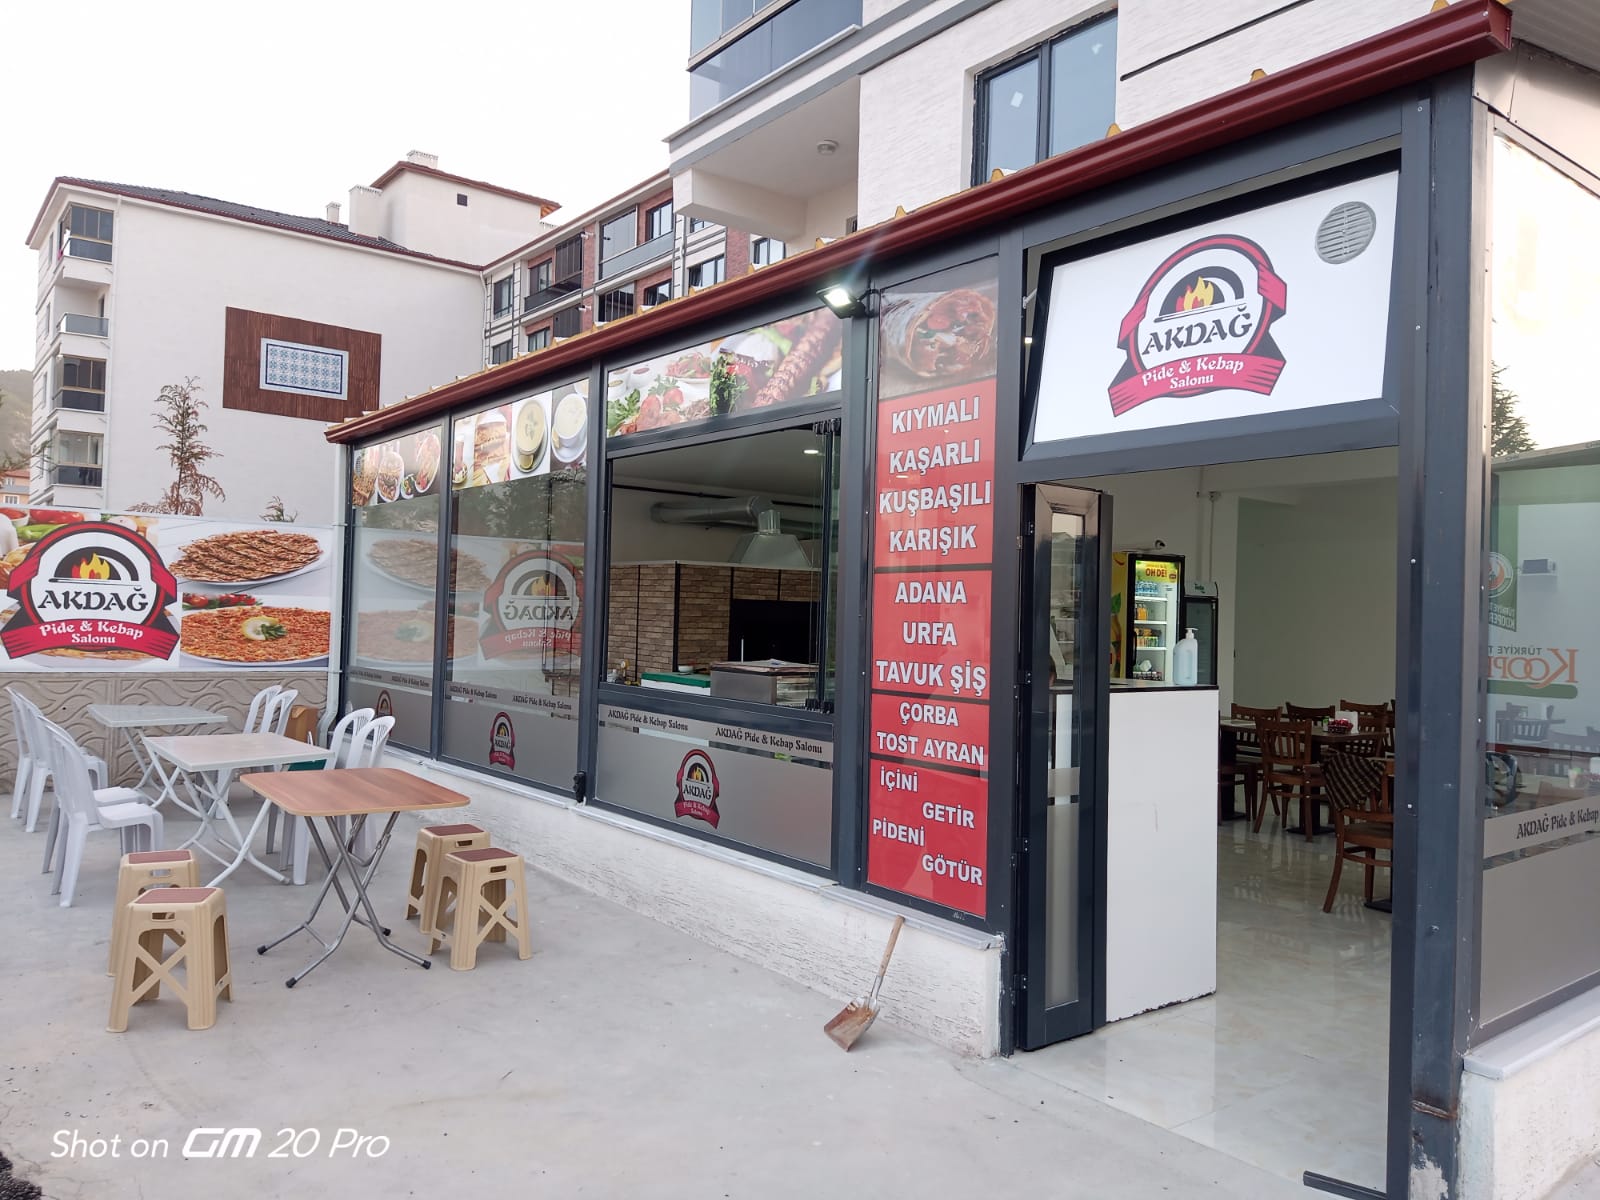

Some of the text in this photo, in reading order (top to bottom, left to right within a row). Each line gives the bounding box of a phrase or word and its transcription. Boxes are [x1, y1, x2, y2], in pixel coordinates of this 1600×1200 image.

[1141, 305, 1252, 355] AKDAĞ
[1142, 356, 1244, 386] Pide & Kebap
[1170, 374, 1214, 389] Salonu
[891, 396, 980, 434] KIYMALI
[889, 438, 980, 475] KAŞARLI
[879, 480, 991, 517] KUŞBAŞILI
[889, 525, 977, 556] KARIŞIK
[37, 587, 149, 611] AKDAĞ
[894, 581, 967, 604] ADANA
[39, 620, 143, 640] Pide & Kebap
[71, 633, 116, 643] Salonu
[903, 621, 957, 646] URFA
[875, 660, 986, 697] TAVUK ŞİŞ
[900, 702, 959, 727] ÇORBA
[715, 727, 743, 740] AKDAĞ
[744, 731, 760, 743] Pide
[769, 735, 794, 751] Kebap
[795, 739, 822, 754] Salonu
[876, 731, 984, 766] TOST AYRAN
[880, 765, 918, 793] İÇİNİ
[922, 801, 975, 829] GETİR
[1516, 813, 1549, 839] AKDAĞ
[1551, 813, 1567, 830] Pide
[1577, 807, 1599, 824] Kebap
[872, 817, 925, 847] PİDENİ
[922, 853, 983, 886] GÖTÜR
